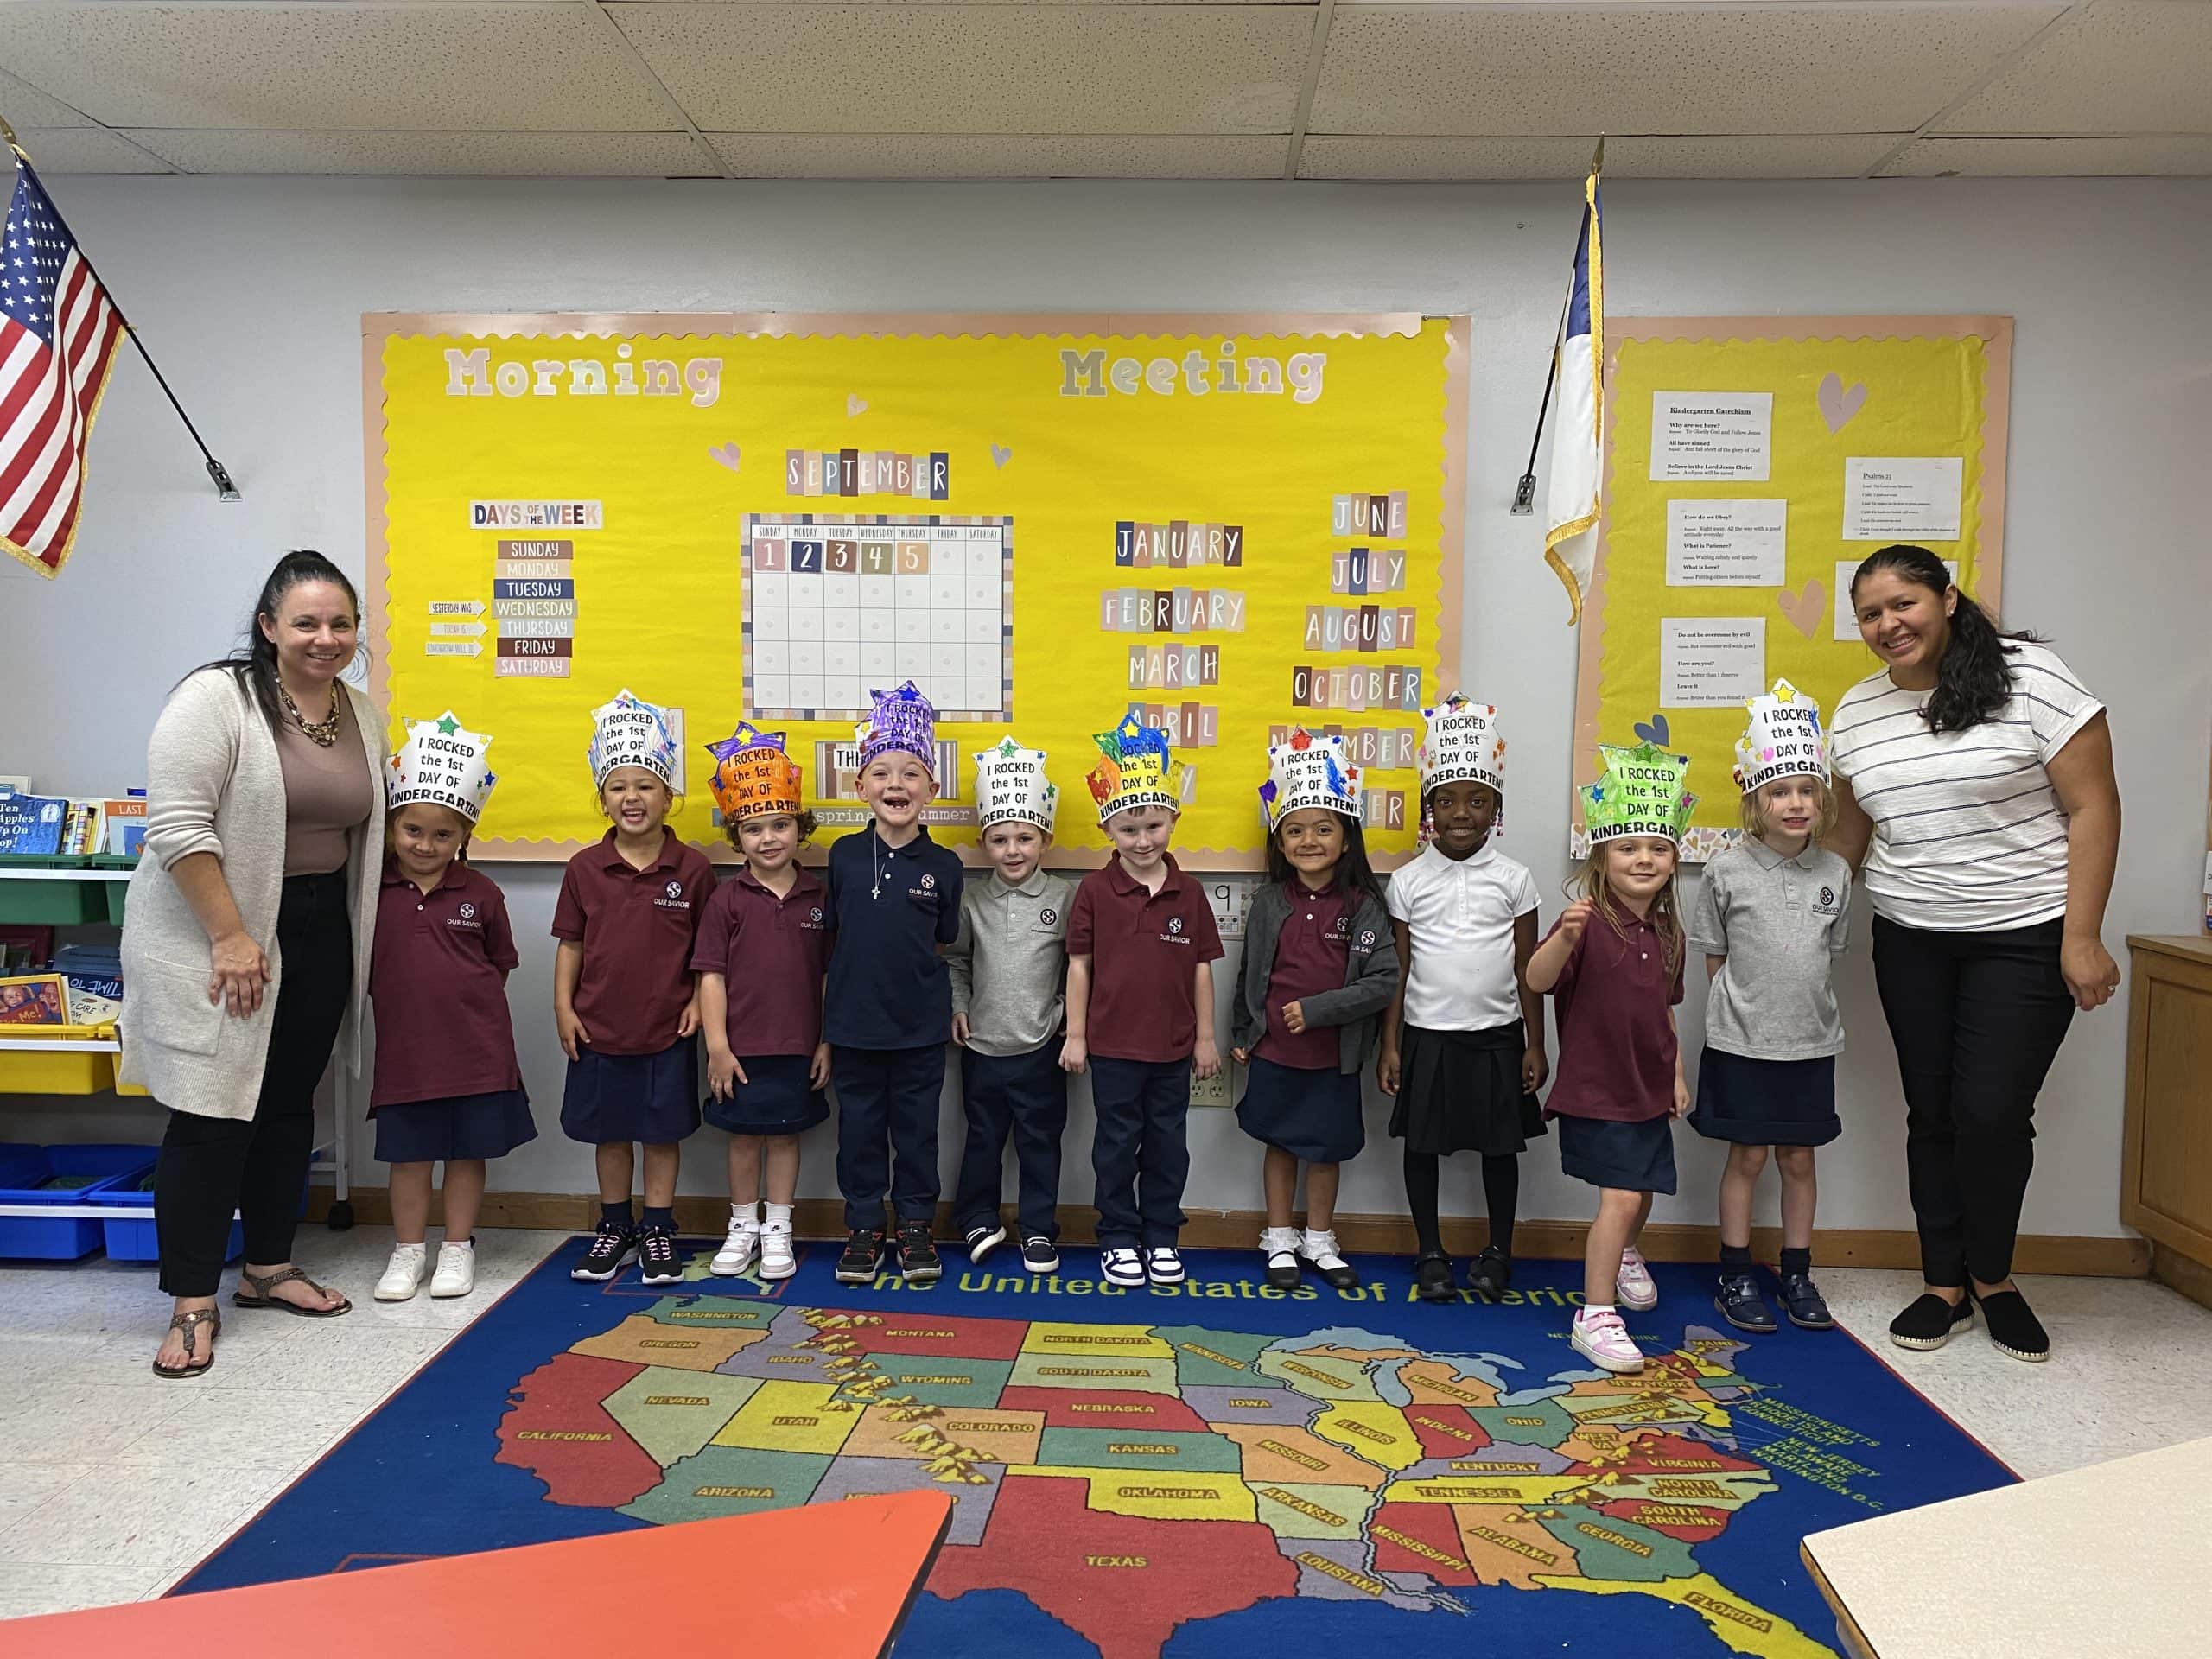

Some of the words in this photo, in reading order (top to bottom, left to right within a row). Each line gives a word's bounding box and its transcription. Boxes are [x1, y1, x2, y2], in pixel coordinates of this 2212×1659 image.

[444, 344, 722, 407] Morning
[1060, 342, 1326, 403] Meeting
[789, 458, 945, 491] SEPTEMBER
[474, 505, 521, 524] DAYS
[527, 505, 539, 514] OF
[544, 505, 598, 524] WEEK
[1335, 497, 1402, 531] JUNE
[525, 516, 543, 524] THE
[760, 527, 780, 537] SUNDAY
[794, 528, 817, 537] MONDAY
[830, 528, 853, 537] TUESDAY
[861, 528, 893, 538] WEDNESDAY
[898, 528, 925, 538] THURSDAY
[938, 530, 957, 539] FRIDAY
[969, 530, 997, 539] SATURDAY
[512, 543, 559, 557] SUNDAY
[1117, 530, 1238, 561] JANUARY
[764, 543, 774, 566] 1
[801, 545, 813, 568] 2
[836, 544, 847, 567] 3
[869, 547, 882, 569] 4
[906, 546, 919, 569] 5
[507, 563, 558, 576] MONDAY
[1333, 557, 1403, 586] JULY
[507, 582, 561, 596] TUESDAY
[432, 603, 460, 613] YESTERDAY
[461, 603, 472, 613] WAS
[497, 601, 572, 616] WEDNESDAY
[1107, 597, 1243, 627] FEBRUARY
[508, 621, 568, 635] THURSDAY
[1306, 614, 1412, 649] AUGUST
[514, 641, 555, 654] FRIDAY
[501, 659, 563, 674] SATURDAY
[1130, 652, 1217, 683] MARCH
[1296, 673, 1419, 702] OCTOBER
[1435, 721, 1438, 733] I
[1443, 718, 1485, 731] ROCKED
[419, 737, 423, 748] I
[428, 738, 474, 758] ROCKED
[1274, 730, 1413, 760] NMBER
[1440, 735, 1458, 747] the
[1464, 734, 1479, 745] 1st
[421, 754, 442, 766] the
[448, 758, 464, 772] 1st
[1441, 751, 1459, 765] DAY
[1465, 751, 1479, 762] OF
[418, 772, 441, 784] DAY
[446, 775, 461, 789] OF
[0, 804, 18, 812] Ten
[119, 805, 142, 814] LAST
[390, 789, 480, 819] KINDERGARTEN!
[817, 807, 875, 823] spring
[918, 809, 969, 820] ummer
[0, 837, 18, 848] op!
[654, 898, 667, 906] OUR
[668, 899, 689, 908] SAVIOR
[71, 978, 85, 988] TO
[88, 980, 121, 996] TIME
[76, 1003, 96, 1014] CARE
[1338, 1282, 1388, 1301] of
[671, 1312, 758, 1320] WASHINGTON
[886, 1330, 955, 1338] MONTANA
[639, 1340, 699, 1349] OREGON
[767, 1356, 814, 1364] IDAHO
[1180, 1343, 1246, 1370] MINNESOTA
[1039, 1368, 1088, 1376] SOUTH
[1091, 1369, 1150, 1377] DAKOTA
[1282, 1361, 1353, 1389] WISCONSIN
[900, 1376, 972, 1384] WYOMING
[1410, 1376, 1476, 1401] MICHIGAN
[645, 1396, 709, 1405] NEVADA
[1072, 1403, 1155, 1413] NEBRASKA
[1575, 1400, 1674, 1420] PENNSYLVANIA
[773, 1417, 817, 1426] UTAH
[948, 1422, 1035, 1433] COLORADO
[1415, 1416, 1473, 1441] INDIANA
[1506, 1417, 1543, 1426] OHIO
[518, 1432, 613, 1442] CALIFORNIA
[1338, 1420, 1396, 1444] ILLINOIS
[1109, 1444, 1177, 1453] KANSAS
[1260, 1440, 1328, 1470] MISSOURI
[1451, 1462, 1539, 1471] KENTUCKY
[1649, 1459, 1721, 1468] VIRGINIA
[1657, 1479, 1717, 1489] NORTH
[696, 1487, 773, 1497] ARIZONA
[1119, 1487, 1217, 1499] OKLAHOMA
[1417, 1488, 1520, 1497] TENNESSEE
[1651, 1489, 1736, 1498] CAROLINA
[1262, 1488, 1347, 1526] ARKANSAS
[1641, 1506, 1700, 1516] SOUTH
[1632, 1516, 1721, 1526] CAROLINA
[1578, 1522, 1652, 1556] GEORGIA
[1371, 1525, 1468, 1571] MISSISSIPPI
[1470, 1527, 1555, 1566] ALABAMA
[1086, 1556, 1147, 1567] TEXAS
[1297, 1552, 1384, 1596] LOUISIANA
[1686, 1592, 1771, 1631] FLORIDA
